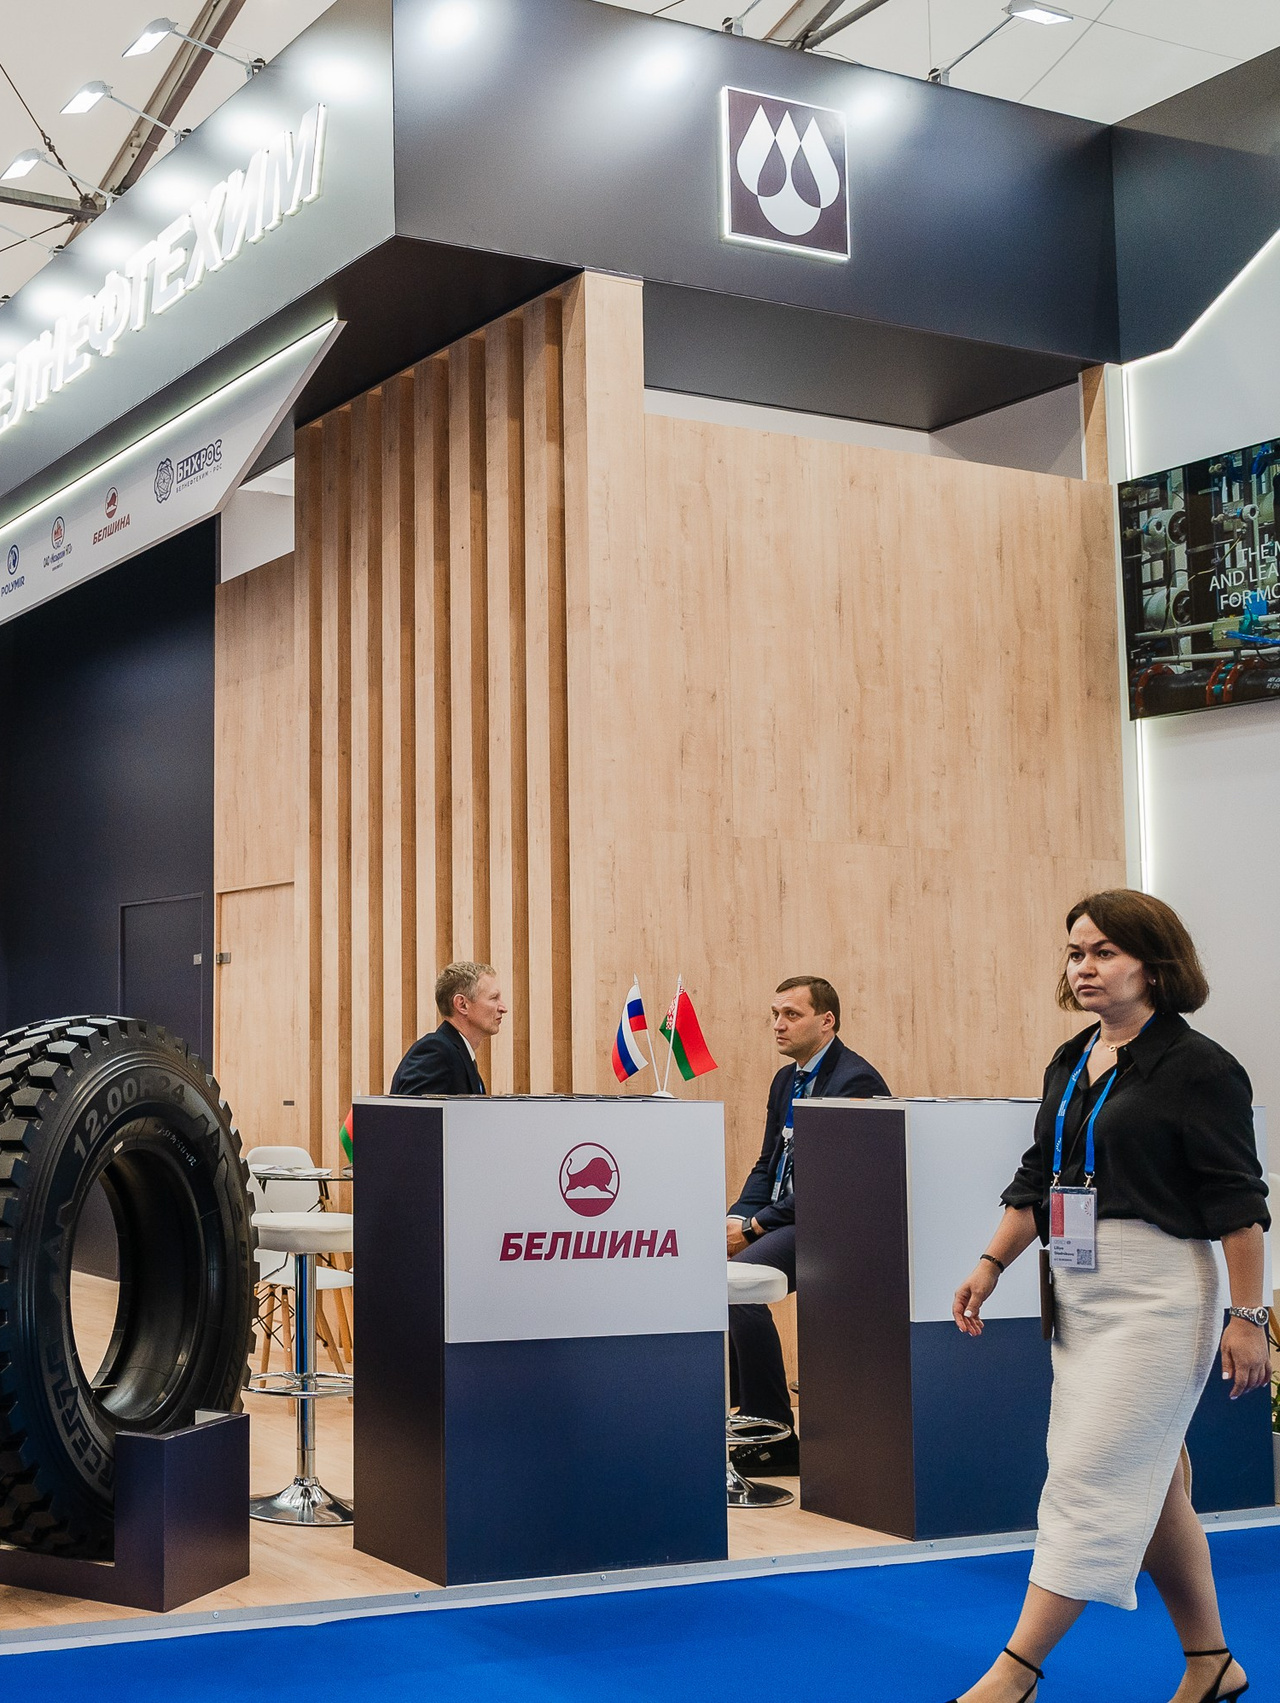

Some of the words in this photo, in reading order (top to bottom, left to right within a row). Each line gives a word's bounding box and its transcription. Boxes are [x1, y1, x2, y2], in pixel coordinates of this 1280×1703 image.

[92, 513, 131, 546] БЕЛШИНА
[0, 575, 25, 597] POLYMIR
[1209, 570, 1245, 592] AND
[1220, 590, 1252, 610] FOR
[73, 1075, 186, 1160] 12.00R24
[498, 1228, 680, 1262] БЕЛШИНА
